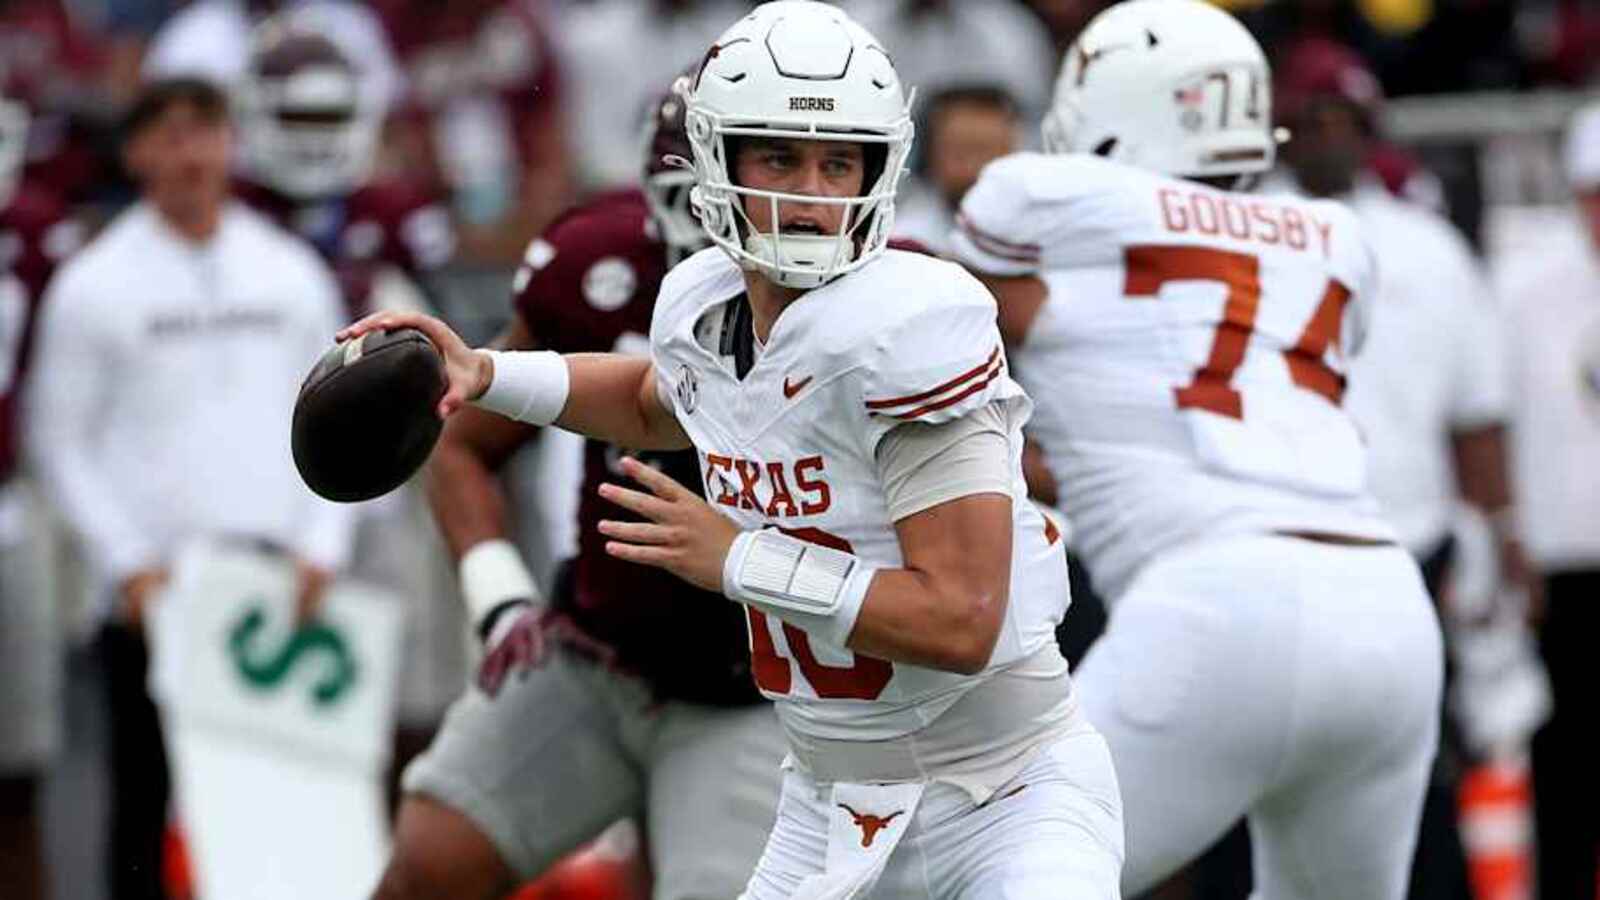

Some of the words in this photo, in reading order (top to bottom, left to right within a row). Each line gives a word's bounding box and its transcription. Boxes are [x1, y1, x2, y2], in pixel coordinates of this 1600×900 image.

[789, 97, 834, 111] HORNS
[1157, 189, 1332, 258] GOOSBY
[1122, 243, 1354, 421] 74
